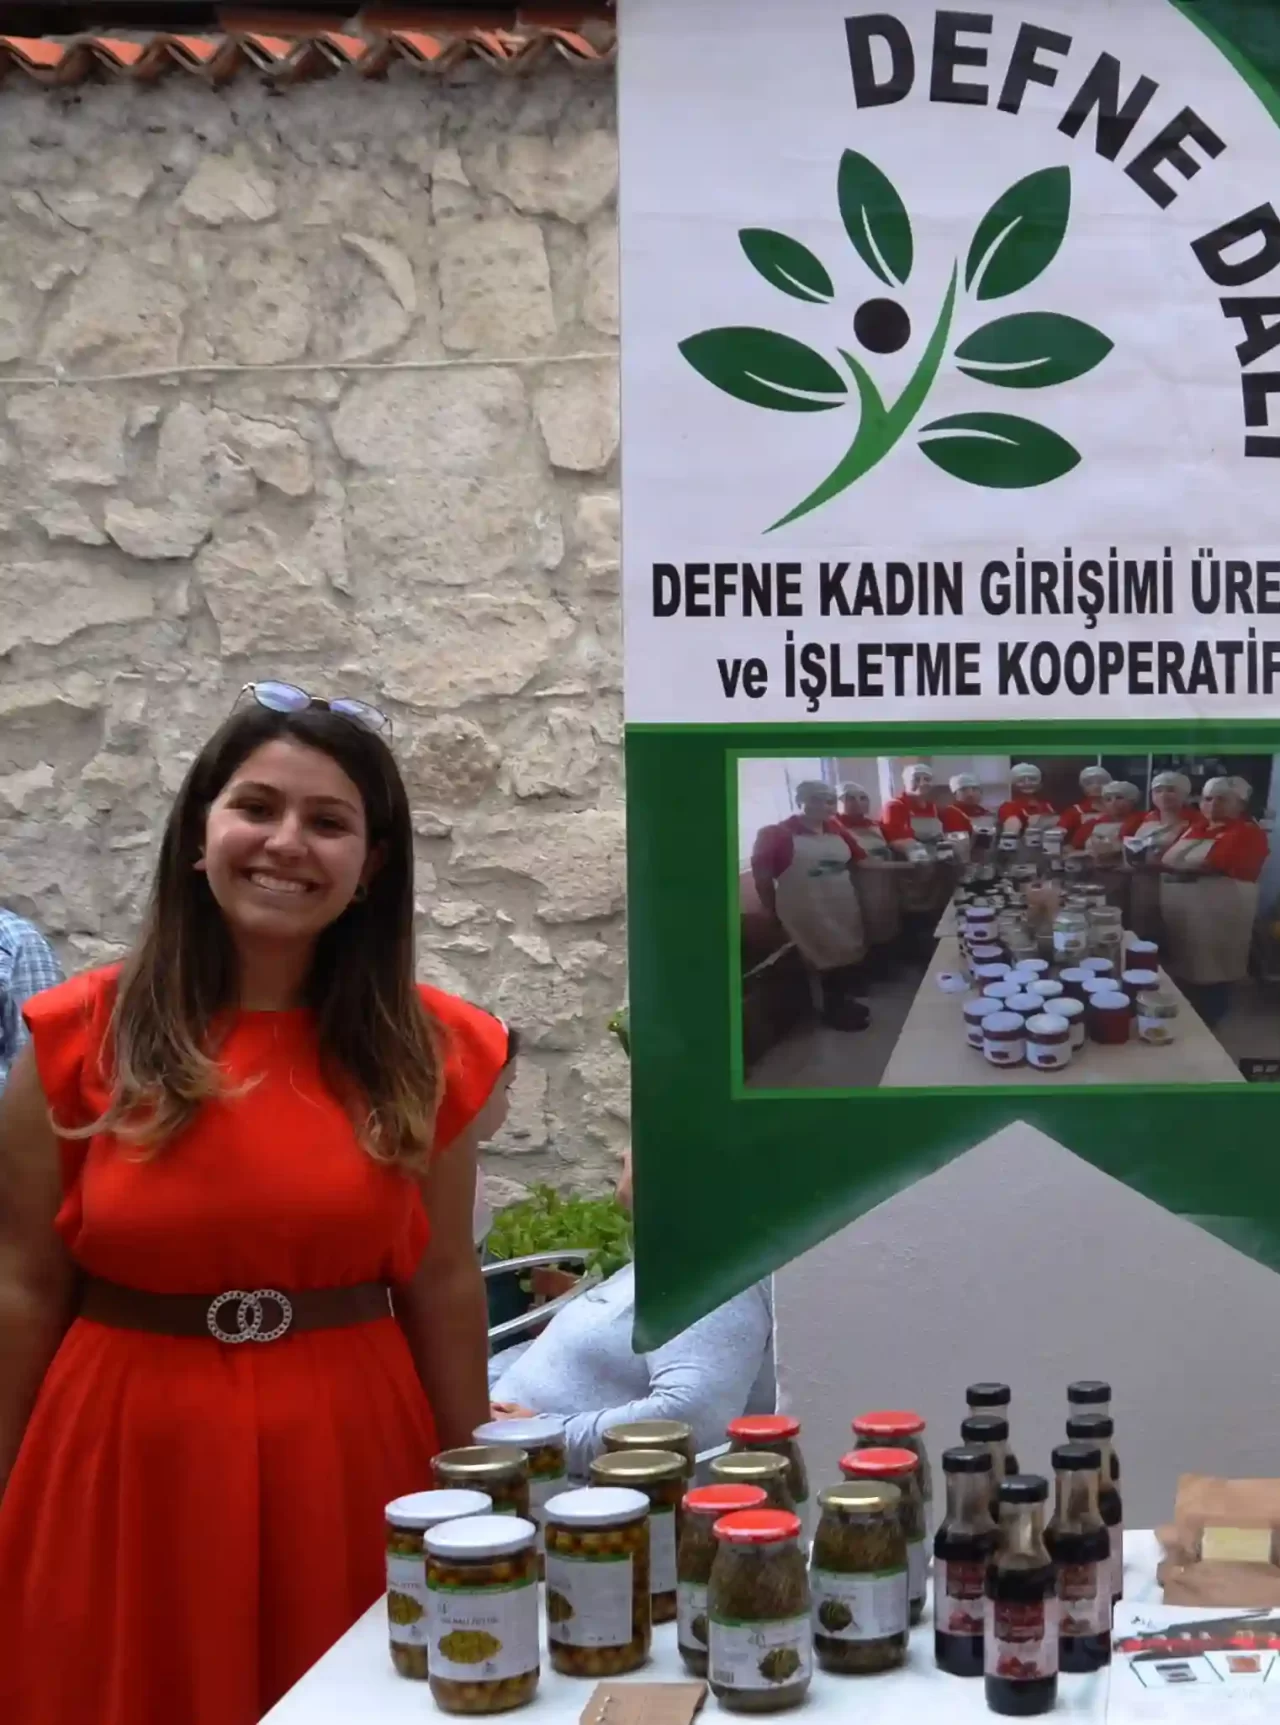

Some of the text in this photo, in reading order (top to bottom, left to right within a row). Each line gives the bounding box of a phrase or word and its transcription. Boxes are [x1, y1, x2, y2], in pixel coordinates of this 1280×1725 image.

[844, 9, 1228, 210] DEFNE
[651, 561, 803, 618] DEFNE
[819, 560, 964, 617] KADIN
[979, 546, 1174, 631] GİRİŞİMİ
[717, 657, 768, 699] ve
[784, 629, 982, 713] İŞLETME
